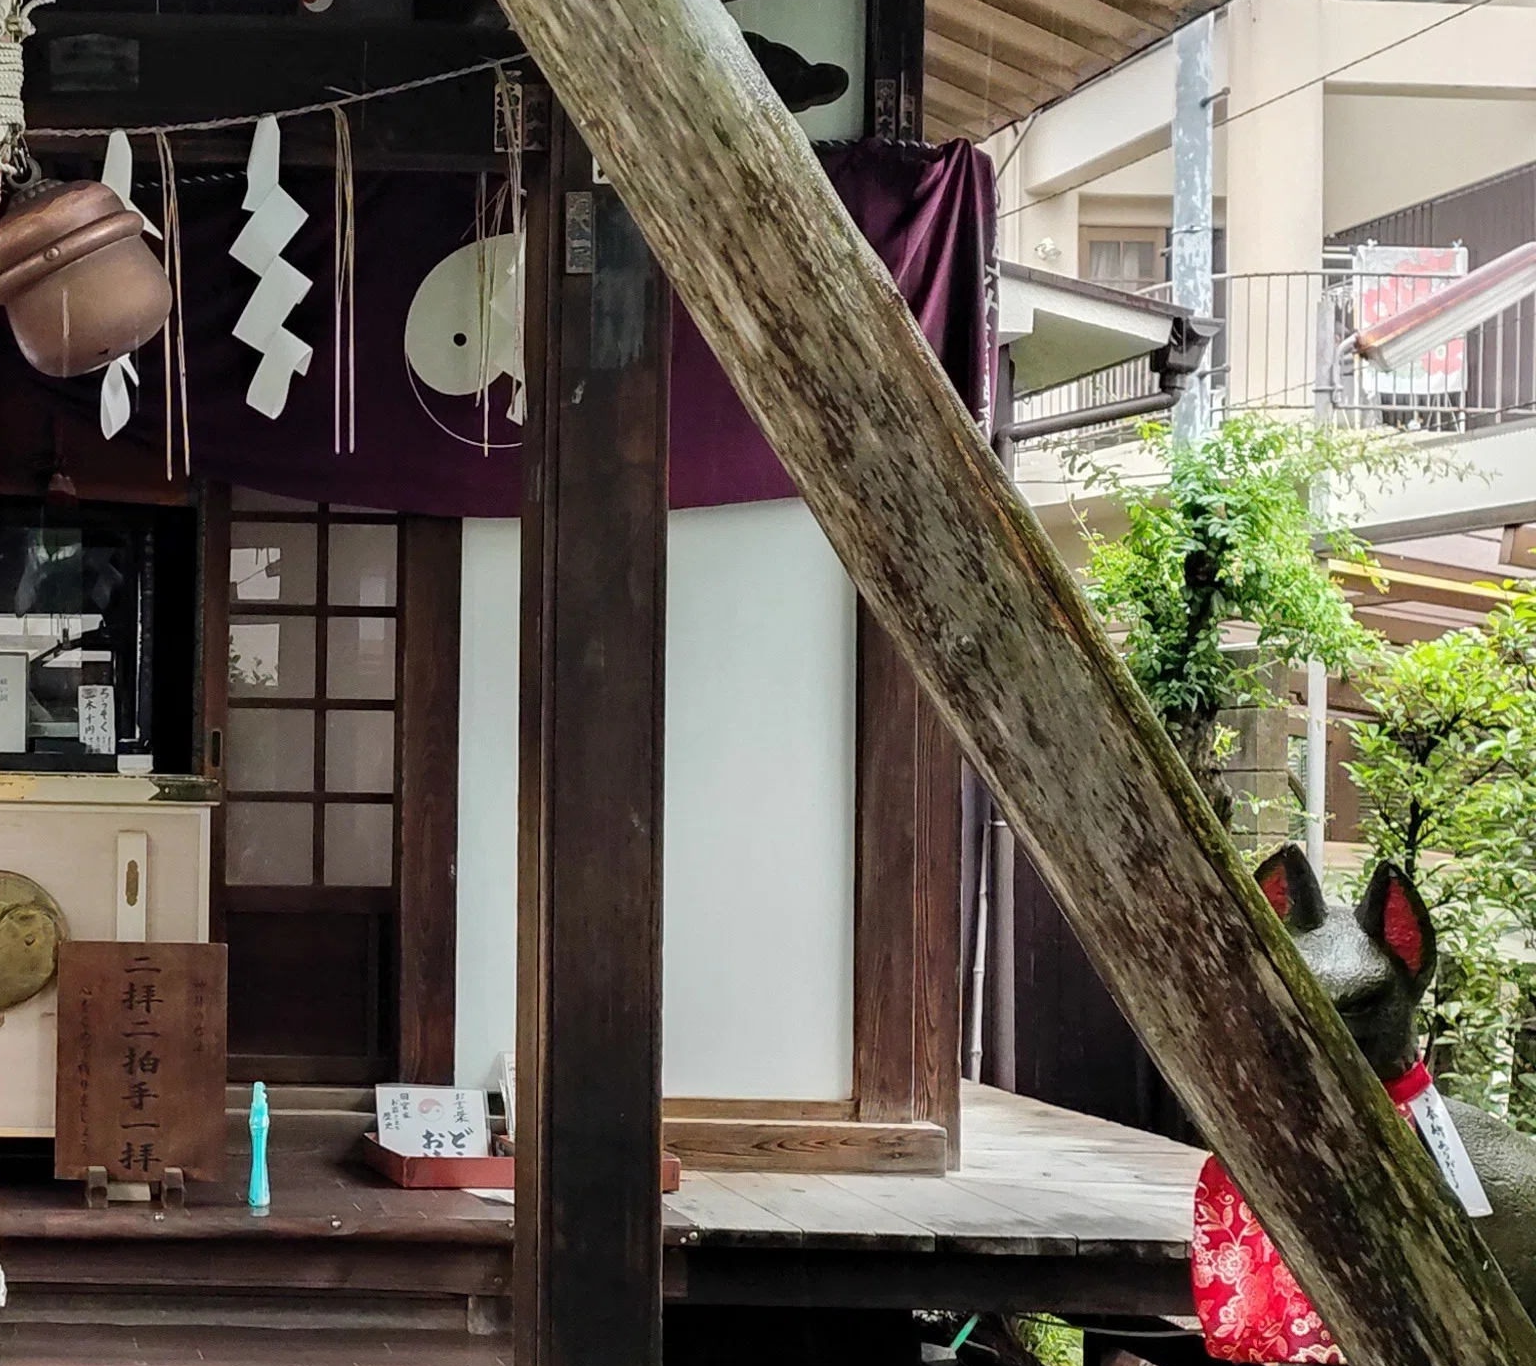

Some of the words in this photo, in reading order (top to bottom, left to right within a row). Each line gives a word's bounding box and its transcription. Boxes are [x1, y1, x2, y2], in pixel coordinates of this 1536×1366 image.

[118, 956, 164, 1172] 二拝二拍手一拝
